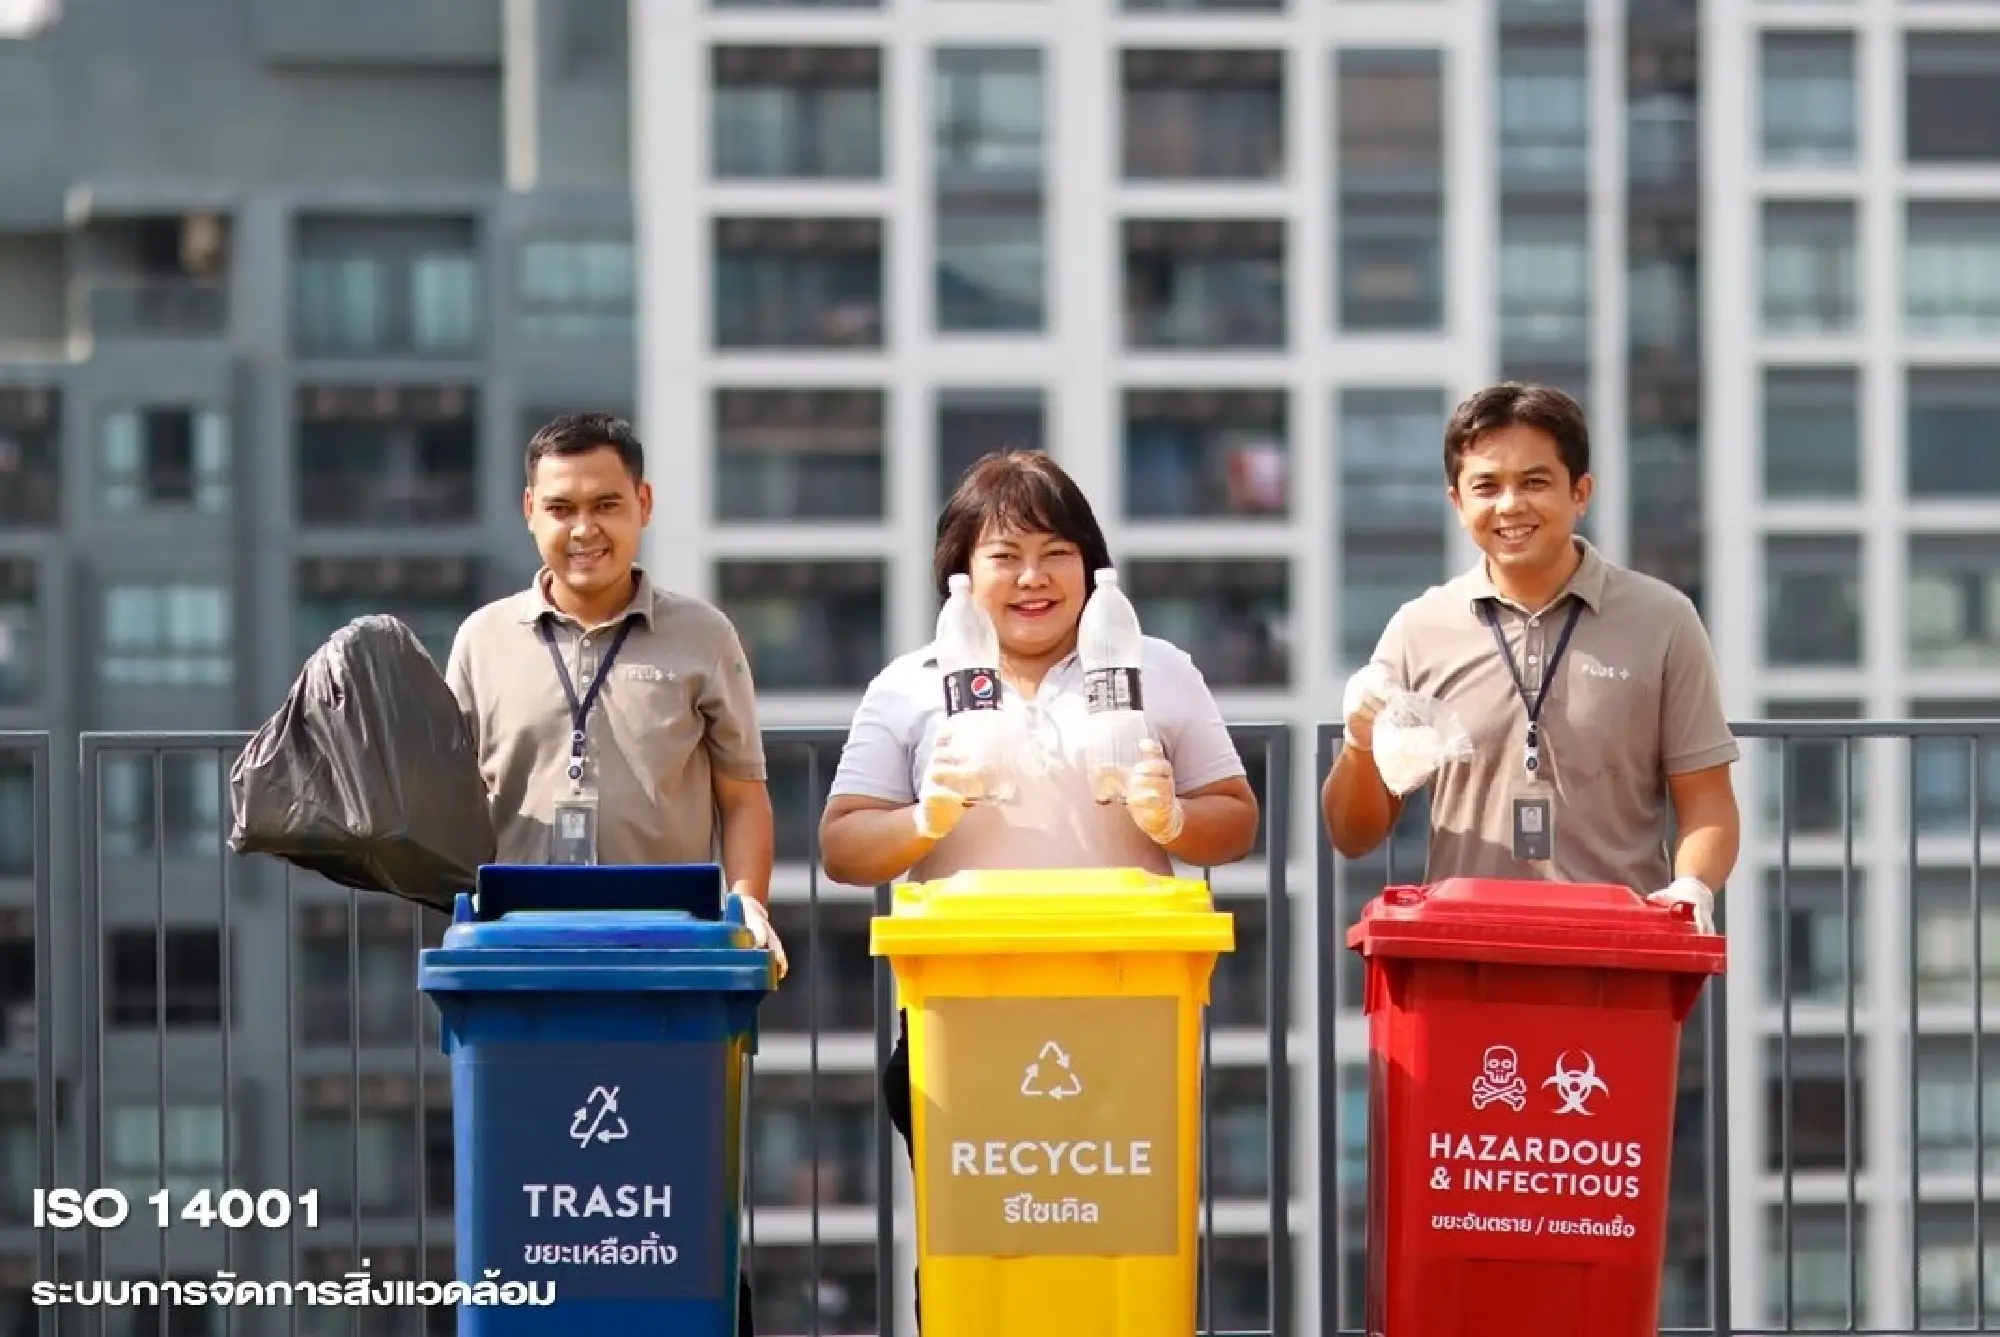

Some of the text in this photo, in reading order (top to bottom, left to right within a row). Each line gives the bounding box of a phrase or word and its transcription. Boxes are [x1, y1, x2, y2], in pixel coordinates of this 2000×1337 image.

[951, 1140, 1152, 1176] RECYCLE
[1429, 1133, 1642, 1168] HAZARDOUS
[1429, 1166, 1640, 1198] & INFECTIOUS
[522, 1183, 672, 1218] TRASH
[1002, 1191, 1099, 1224] รีไซเคิล
[523, 1231, 679, 1265] ขยะเหลือทิ้ง
